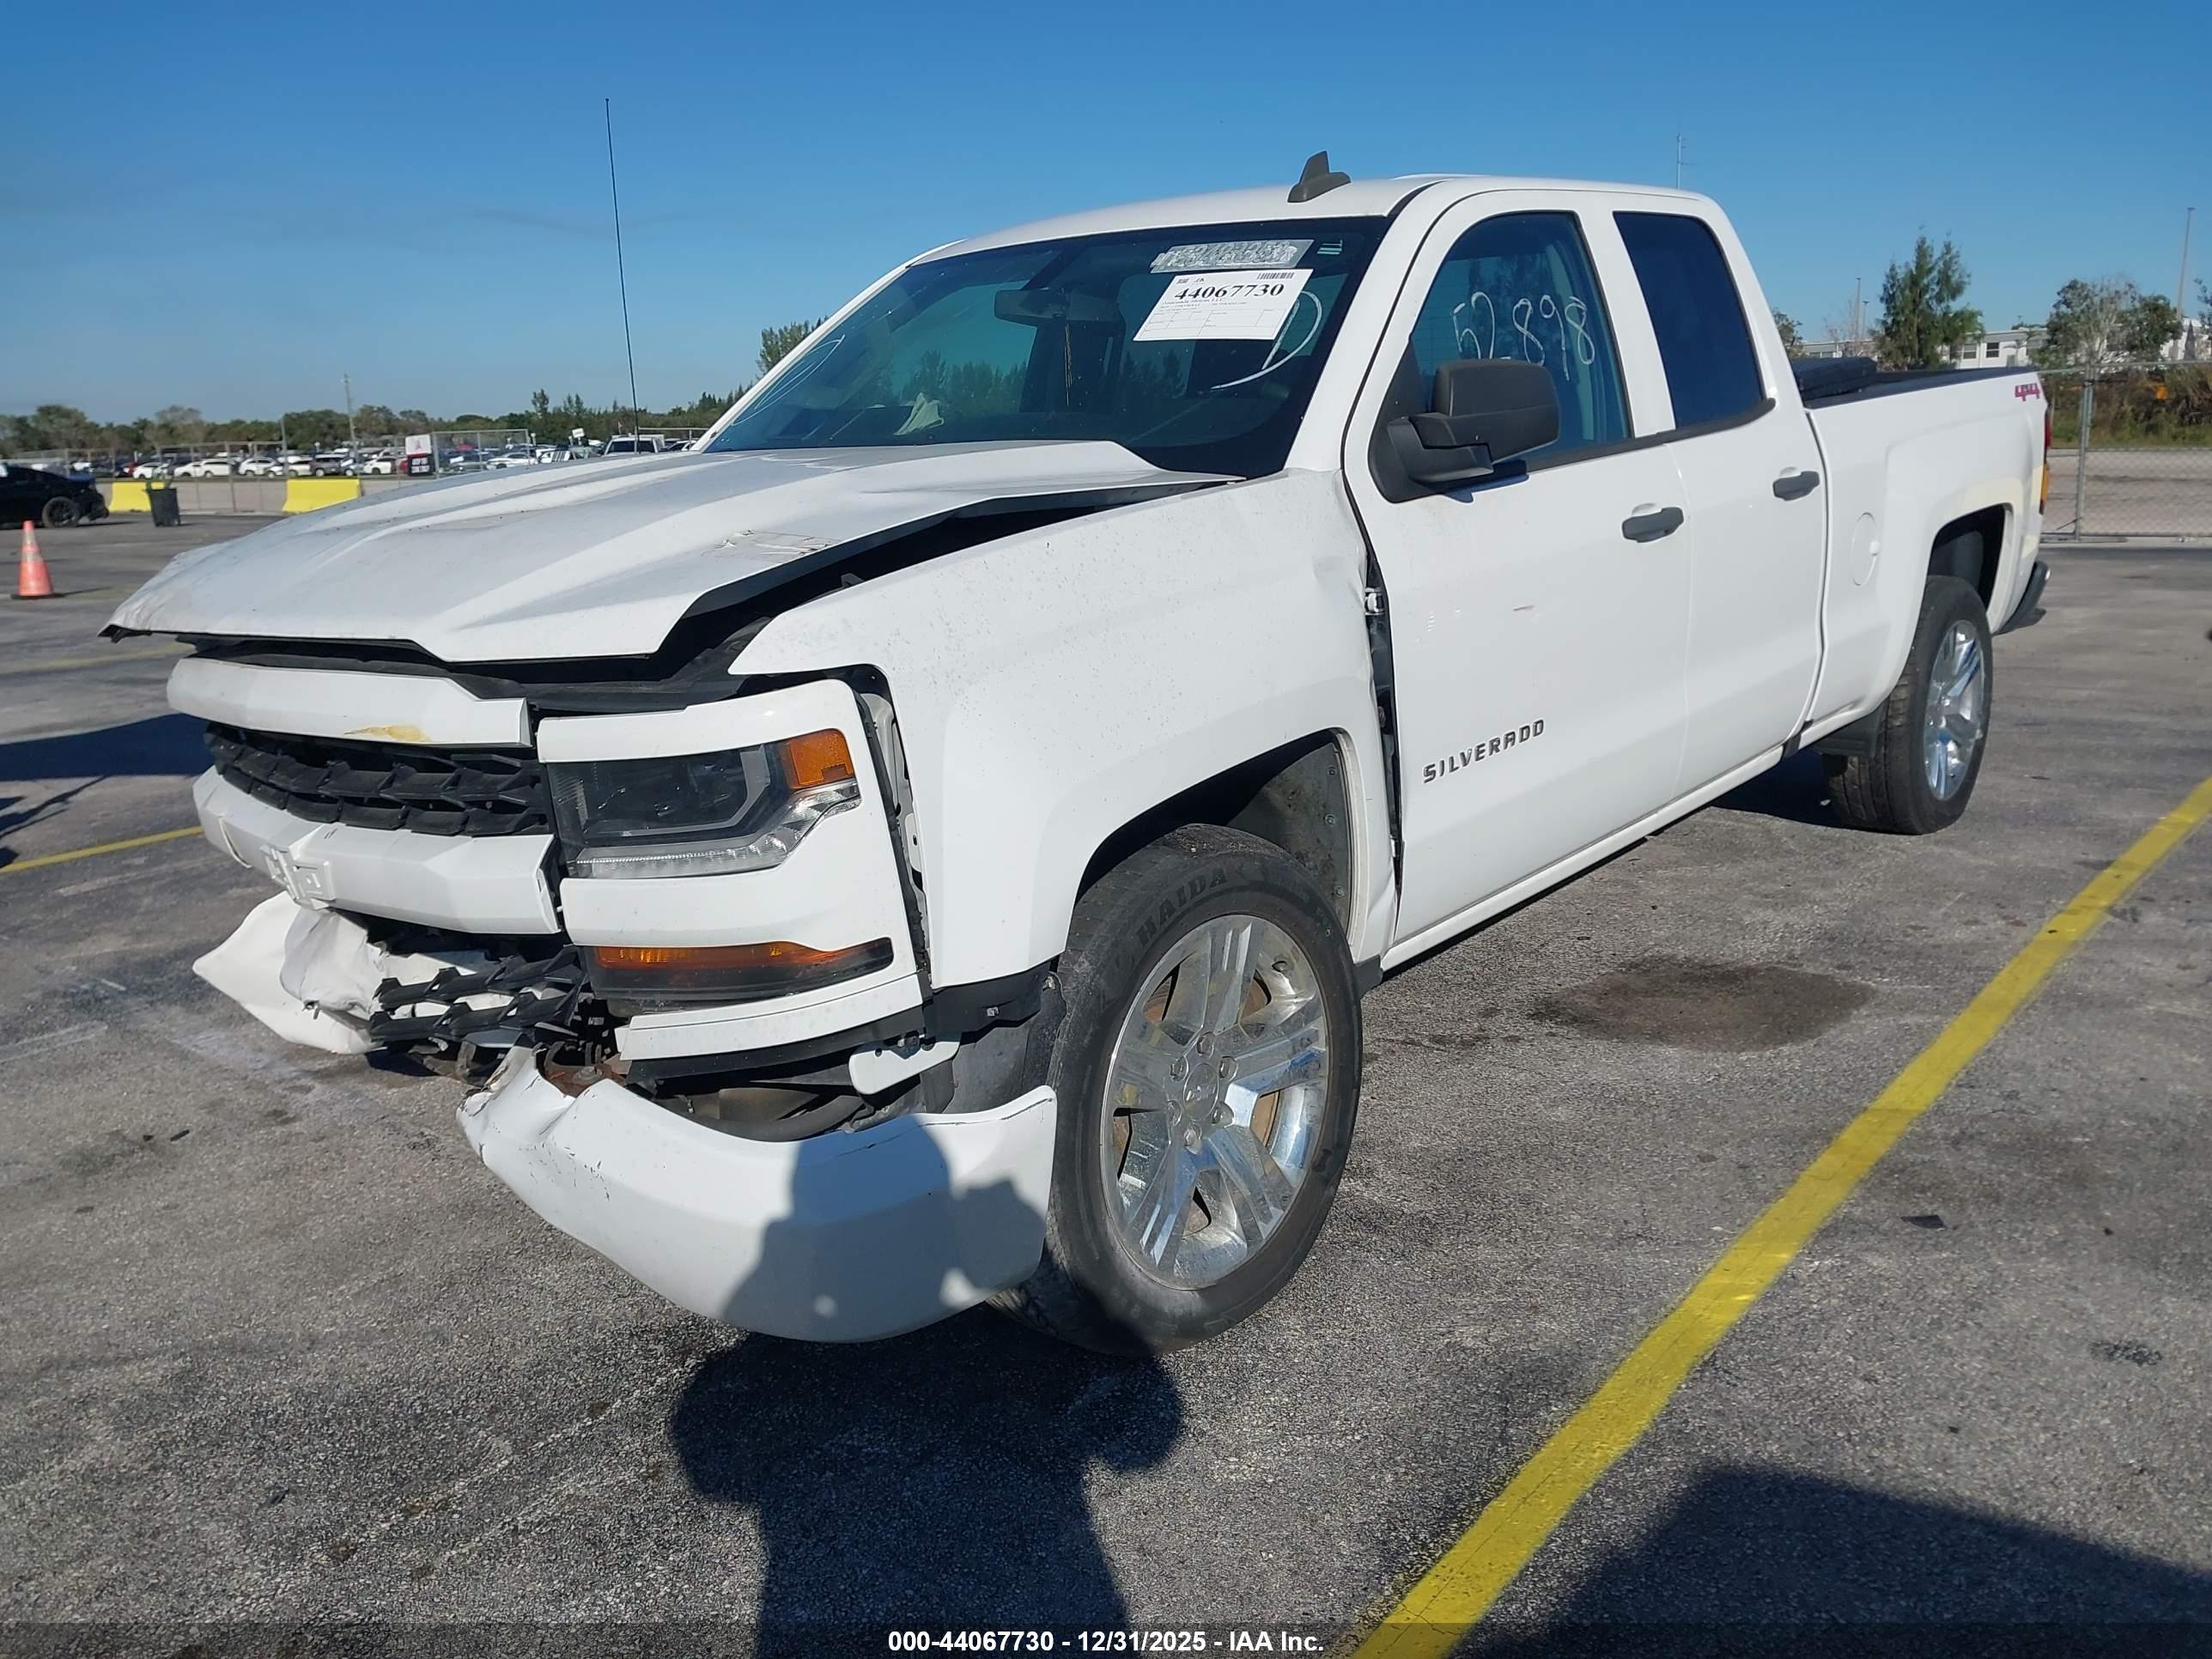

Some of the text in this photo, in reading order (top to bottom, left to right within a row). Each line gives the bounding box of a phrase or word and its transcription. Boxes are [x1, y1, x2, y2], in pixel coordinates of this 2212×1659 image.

[1174, 283, 1285, 301] 44067730
[1423, 719, 1544, 783] SILVERADO
[1136, 868, 1227, 945] HAIDA
